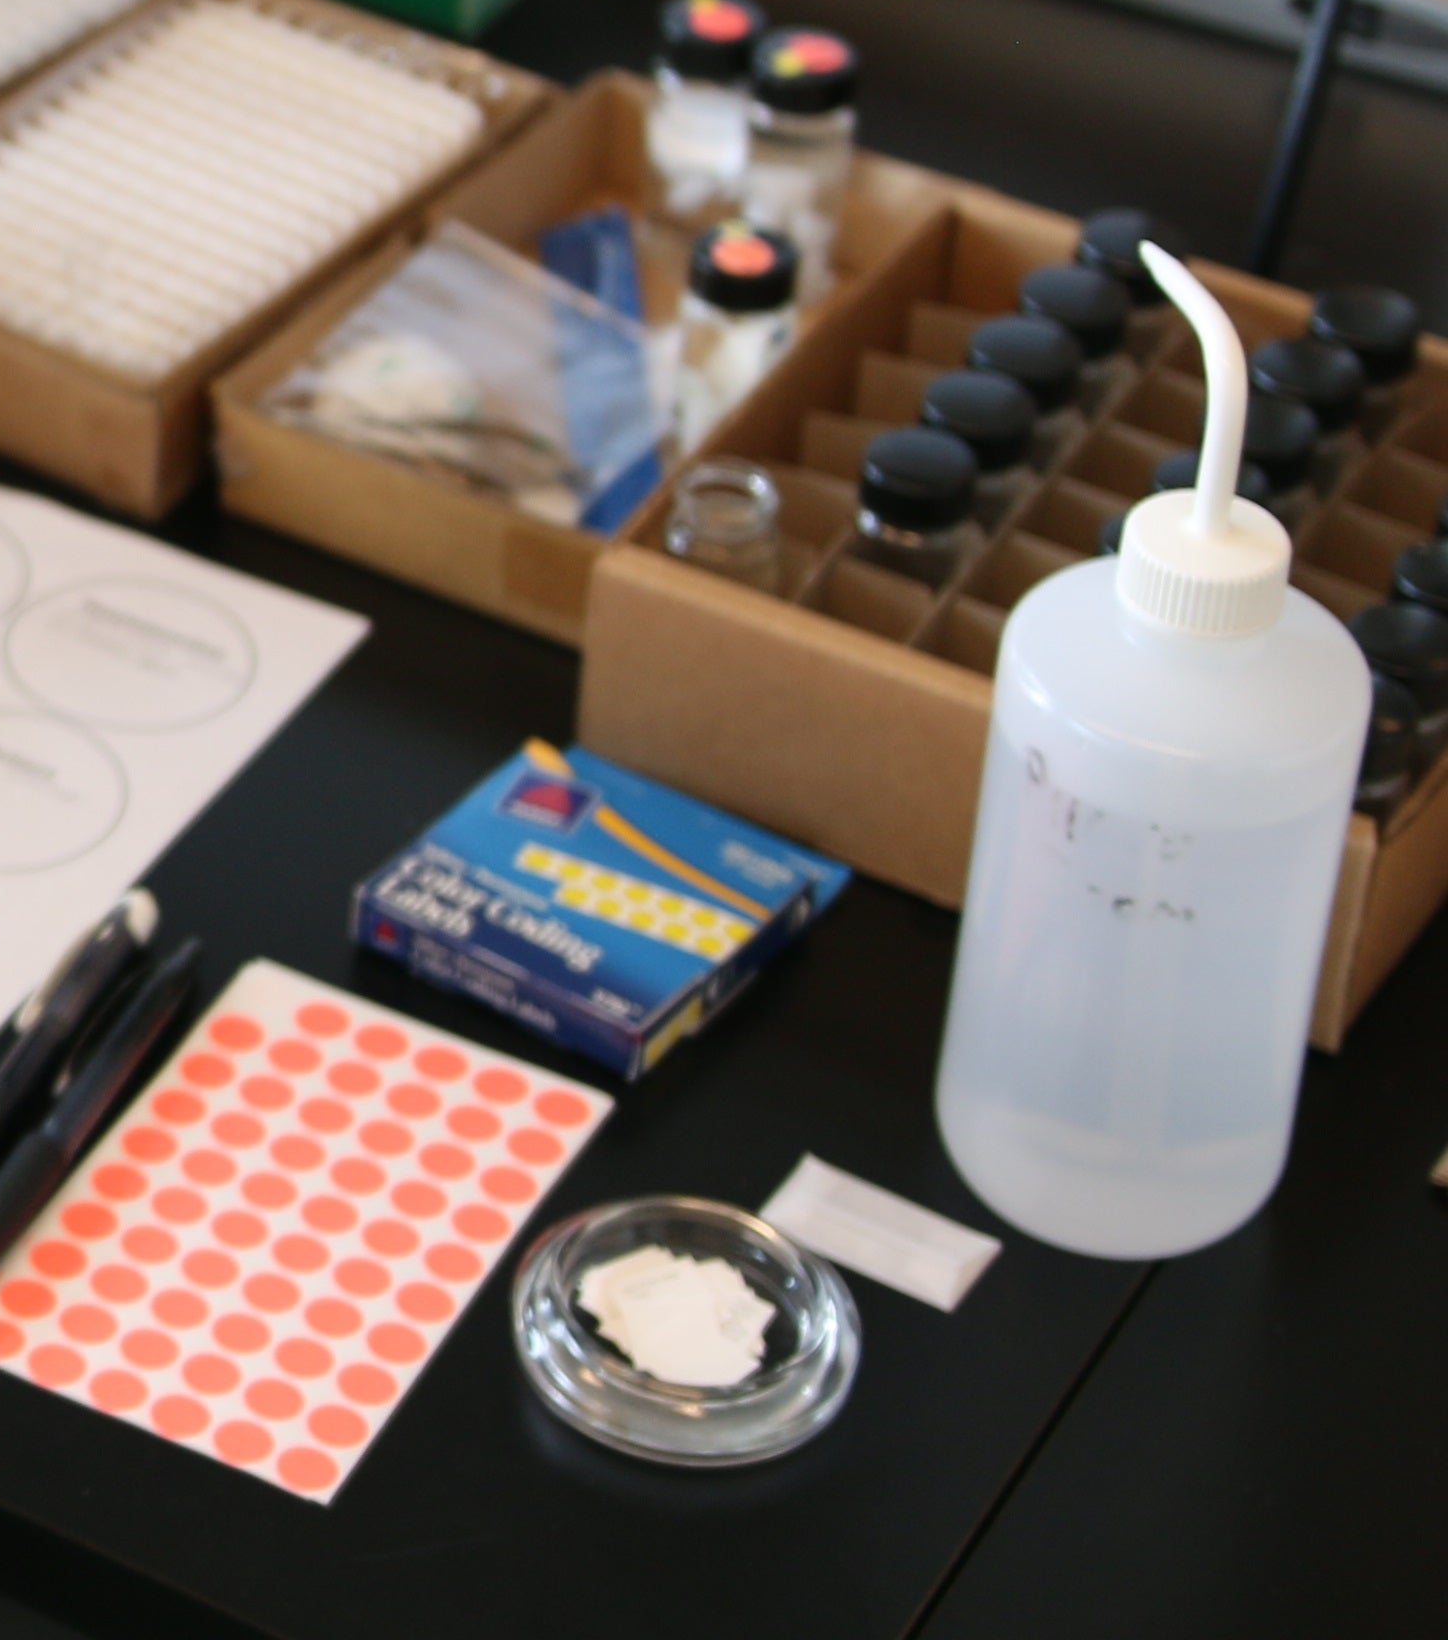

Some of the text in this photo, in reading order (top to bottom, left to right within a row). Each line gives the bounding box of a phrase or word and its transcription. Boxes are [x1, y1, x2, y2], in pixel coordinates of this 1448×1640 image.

[376, 870, 474, 938] Labels
[396, 853, 489, 908] Color
[484, 897, 604, 974] Coding
